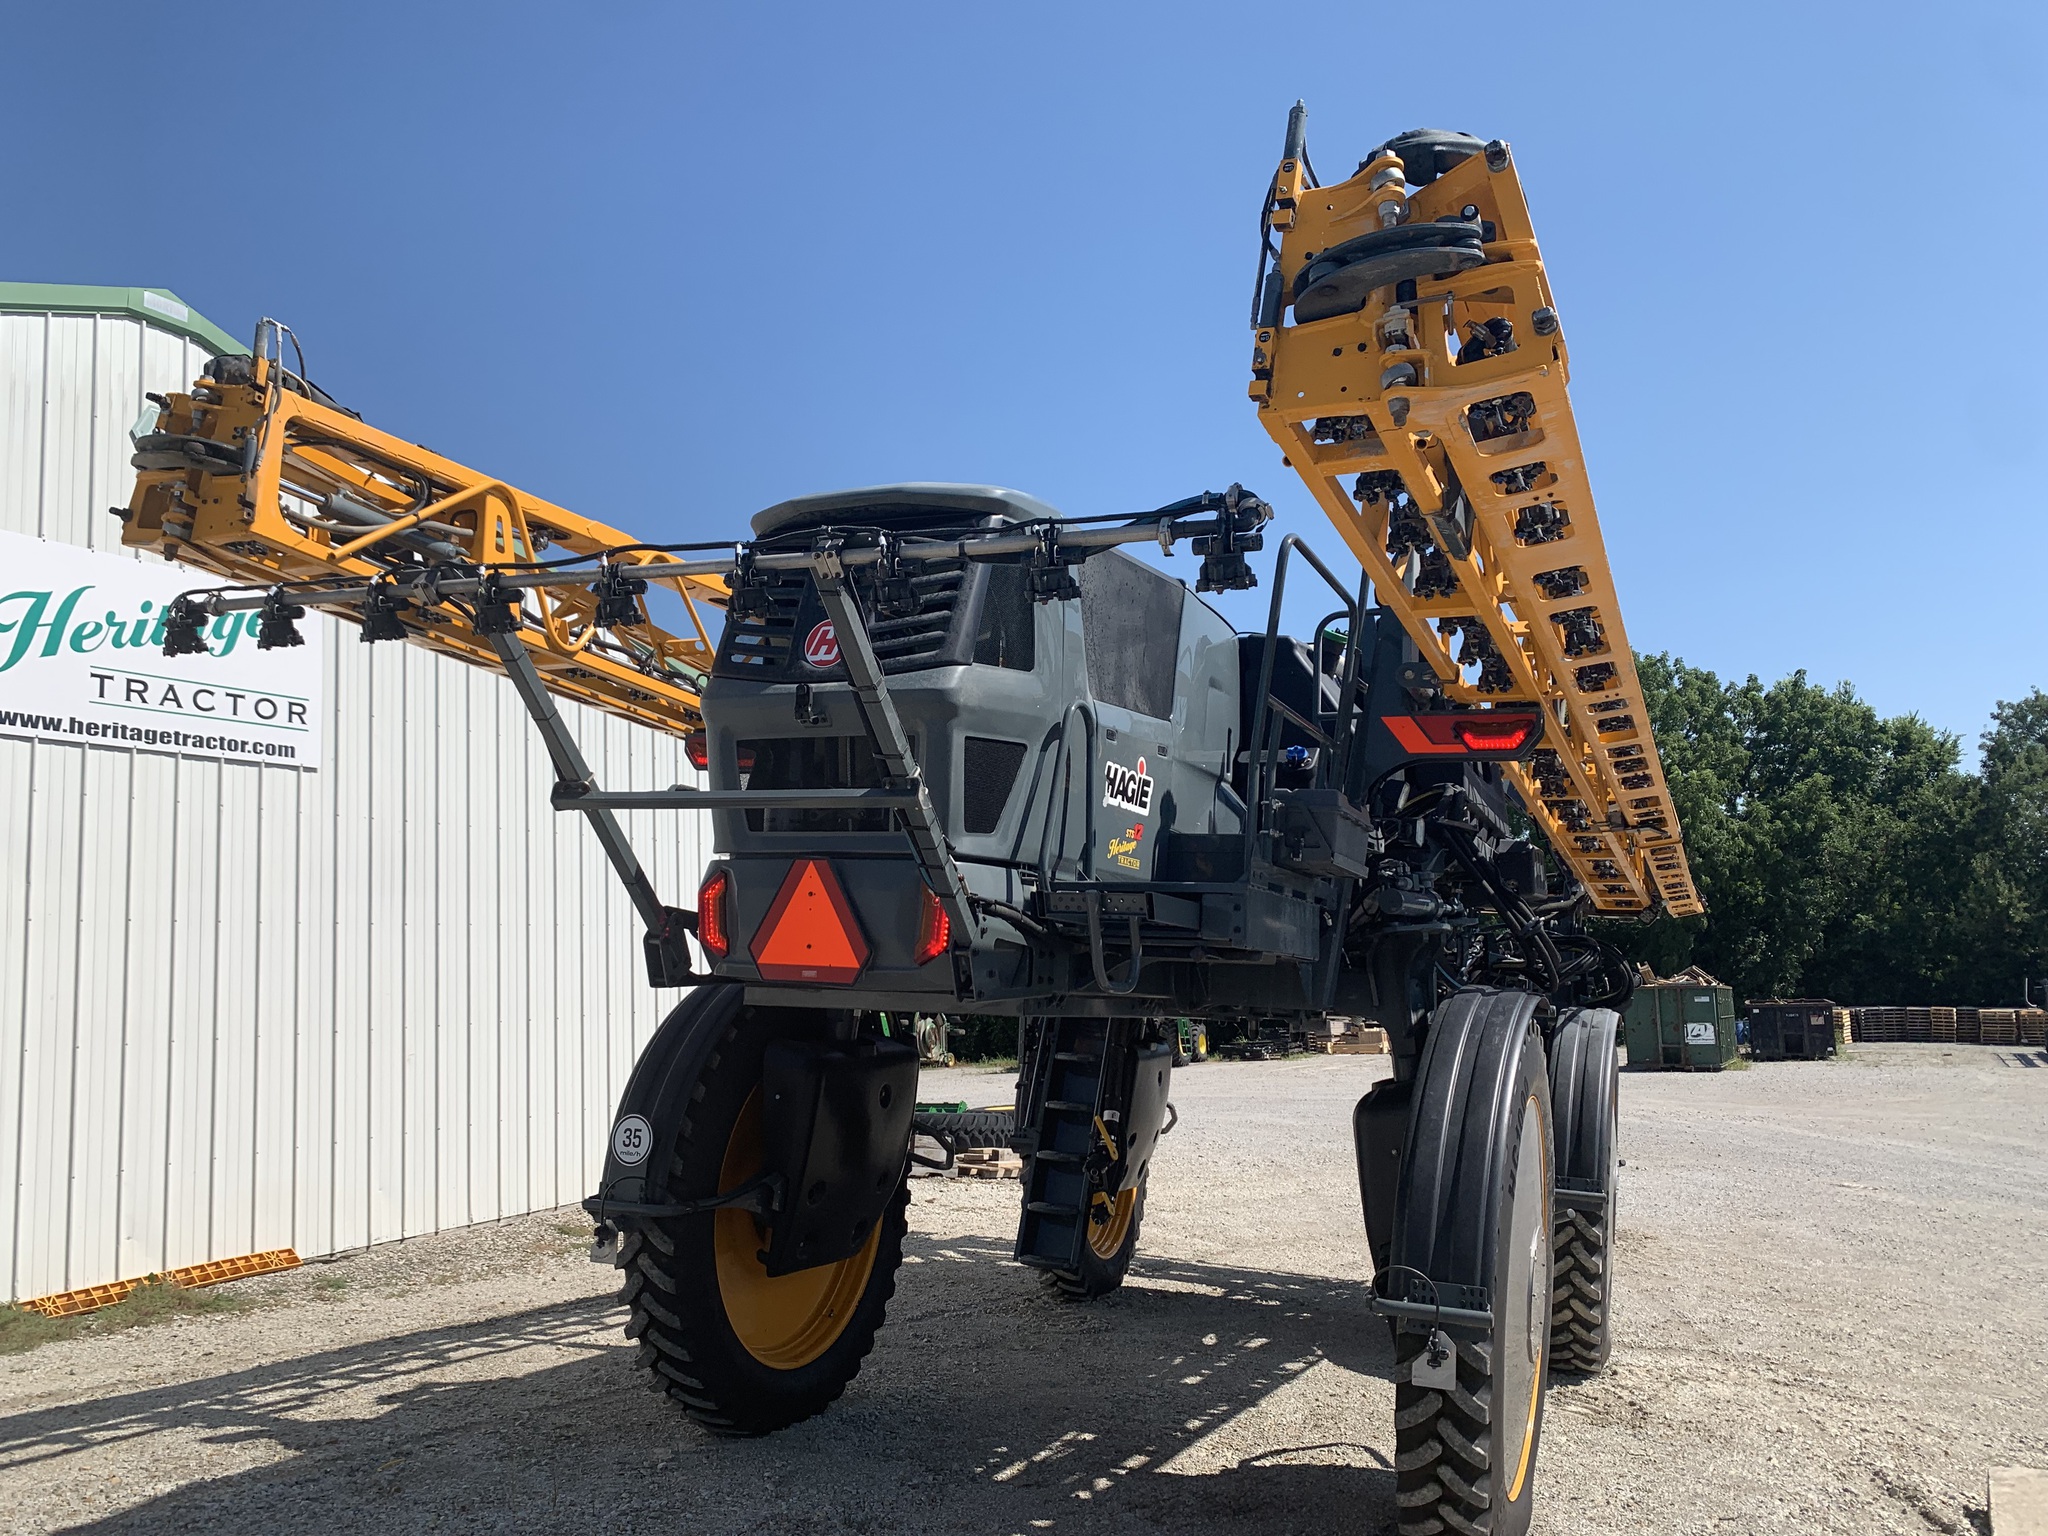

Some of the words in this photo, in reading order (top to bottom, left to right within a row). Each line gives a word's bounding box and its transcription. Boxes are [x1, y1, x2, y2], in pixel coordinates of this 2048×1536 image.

[90, 672, 308, 725] TRACTOR
[0, 709, 296, 759] www.heritagetractor.com
[1105, 760, 1152, 810] HAGIE
[1107, 838, 1137, 858] Heritage
[1118, 856, 1140, 868] TRACTOR
[622, 1128, 642, 1148] 35
